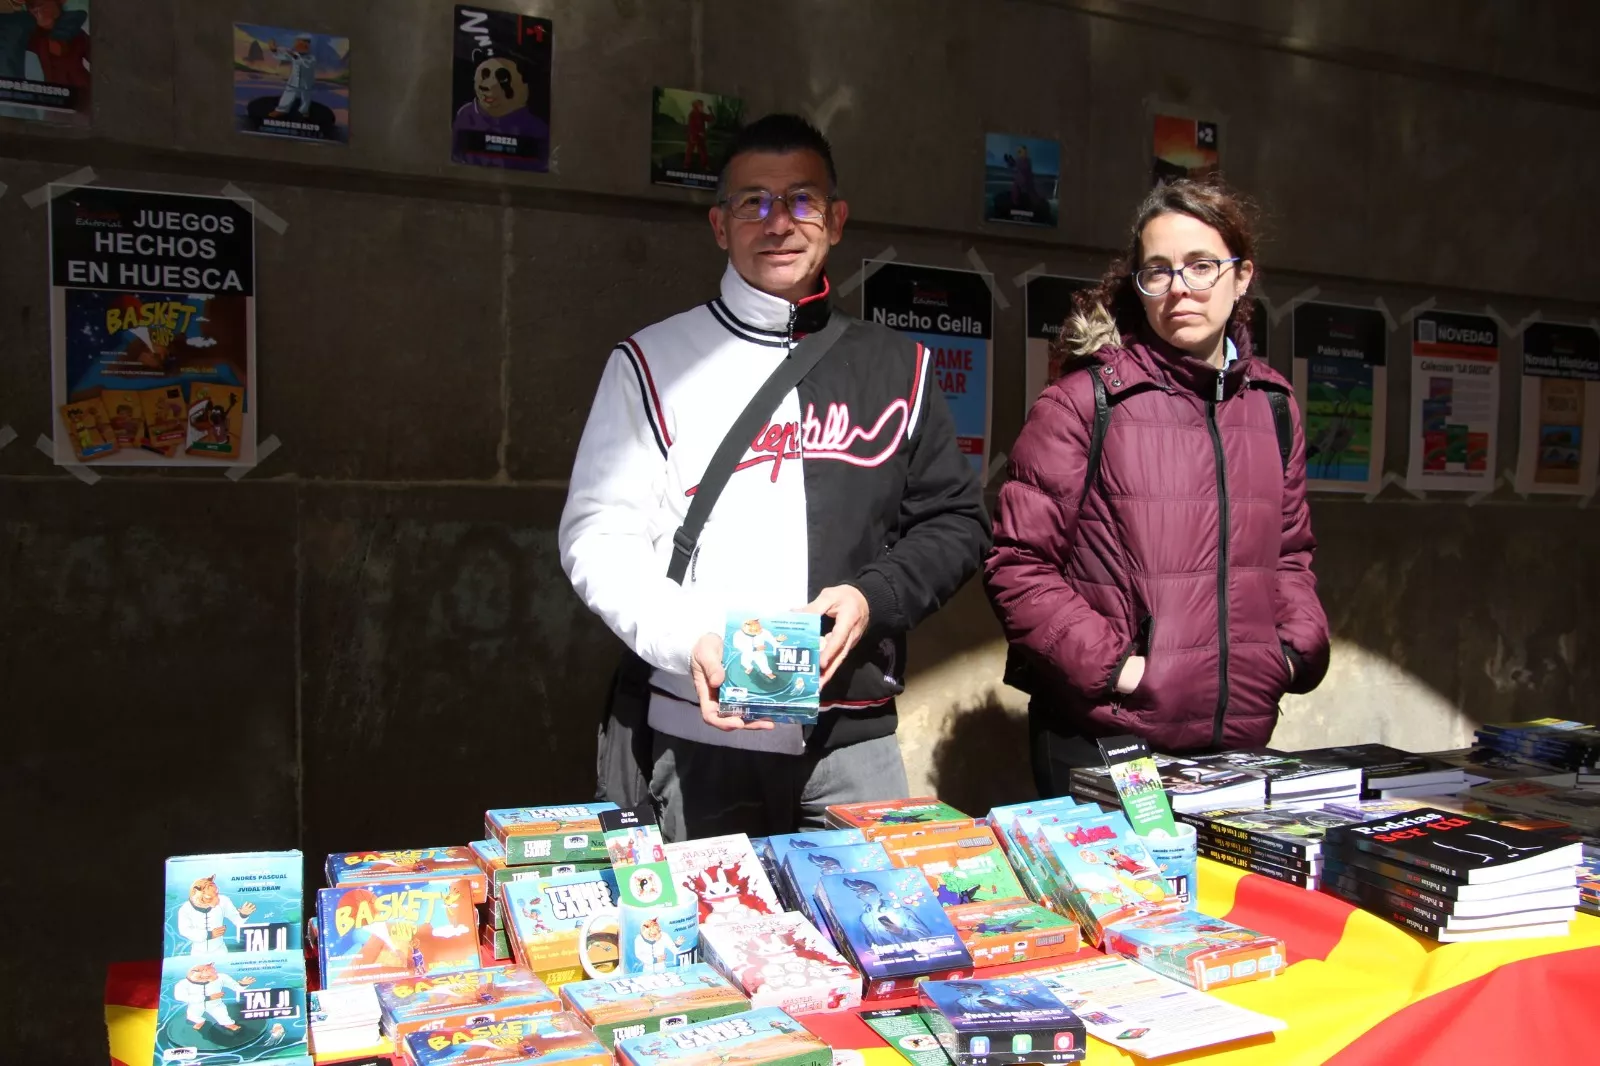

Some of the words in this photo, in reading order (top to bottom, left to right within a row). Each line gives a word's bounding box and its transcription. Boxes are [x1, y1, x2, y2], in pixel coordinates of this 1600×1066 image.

[485, 134, 518, 146] PEREZA
[132, 209, 235, 234] JUEGOS
[95, 231, 217, 260] HECHOS
[68, 260, 109, 284] EN
[119, 263, 243, 292] HUESCA
[106, 301, 196, 335] BASKET
[872, 307, 932, 331] Nacho
[937, 313, 982, 335] Gella
[1438, 325, 1494, 345] NOVEDAD
[1372, 824, 1428, 843] ser
[344, 850, 437, 866] BASKET
[335, 889, 442, 937] BASKET
[392, 971, 495, 999] BASKET
[244, 992, 271, 1009] TAI
[276, 990, 291, 1009] JI
[427, 1020, 539, 1051] BASKET
